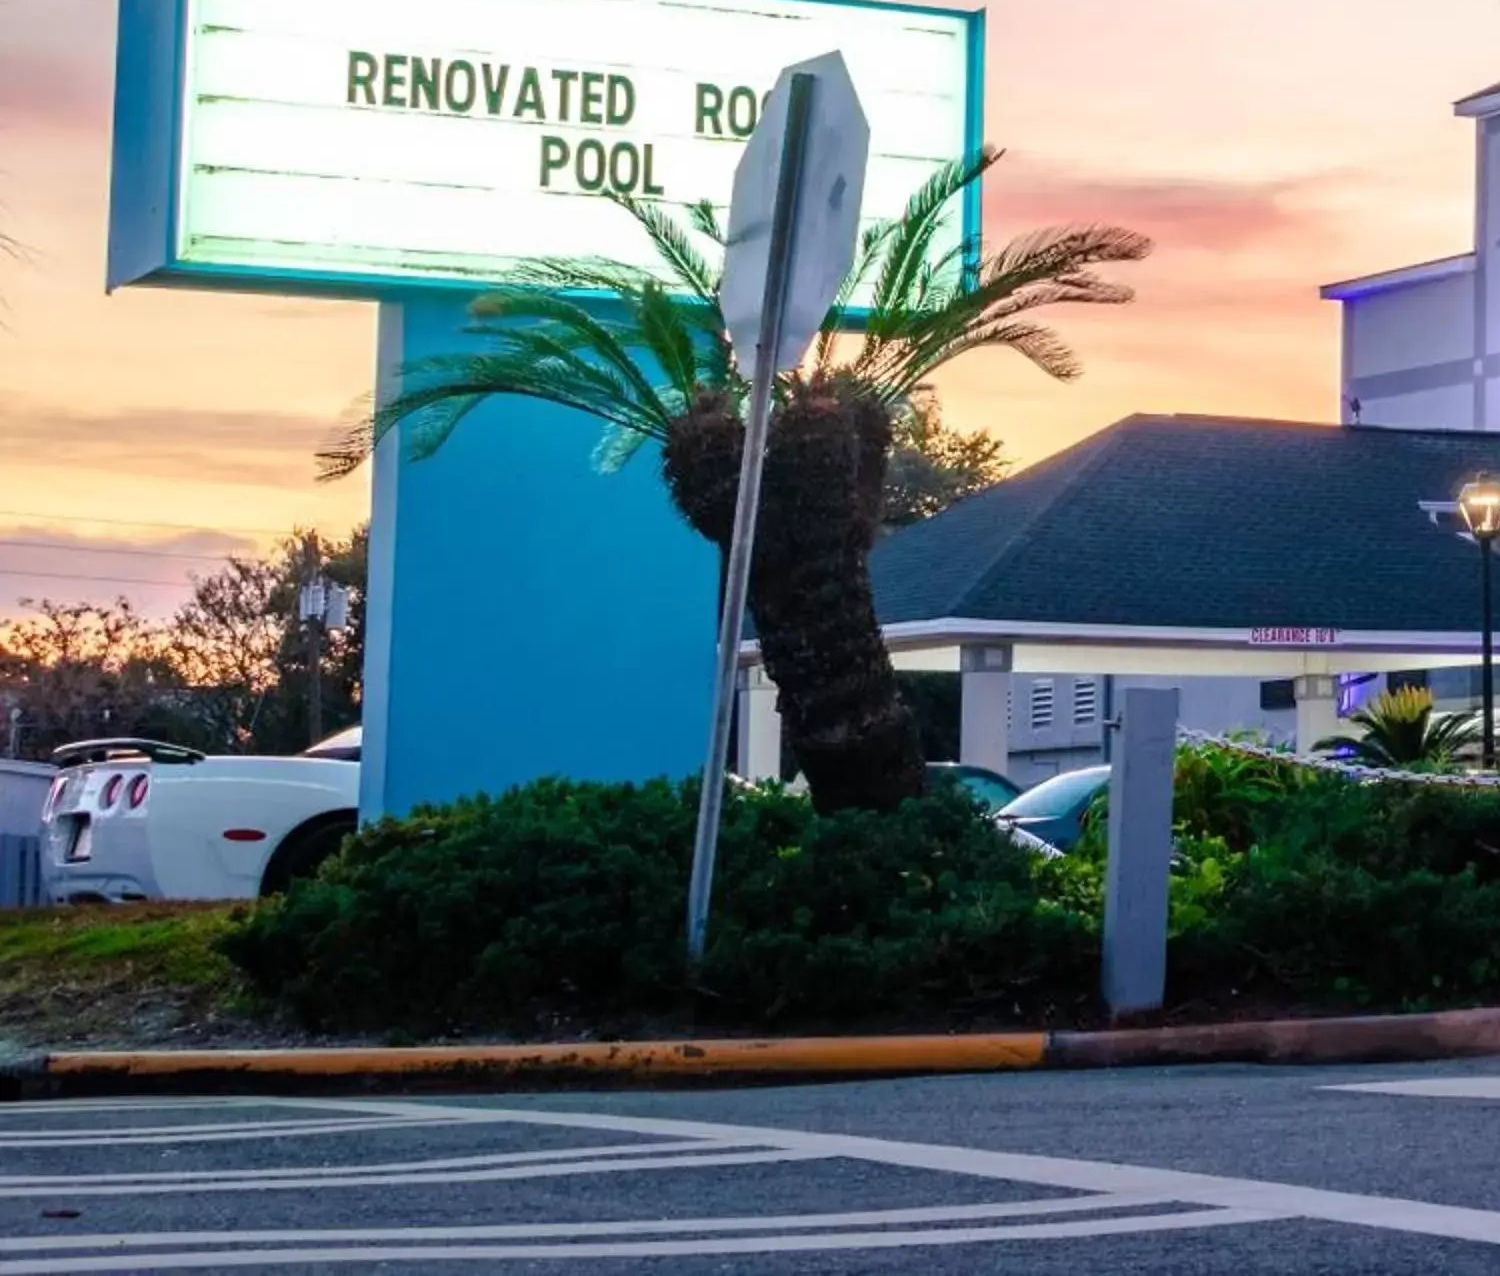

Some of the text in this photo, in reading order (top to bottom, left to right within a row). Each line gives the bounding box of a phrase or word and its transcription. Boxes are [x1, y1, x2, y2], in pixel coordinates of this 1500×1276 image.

[346, 50, 772, 137] RENOVATED RO
[538, 134, 666, 198] POOL
[1251, 627, 1310, 643] CLEARANCE
